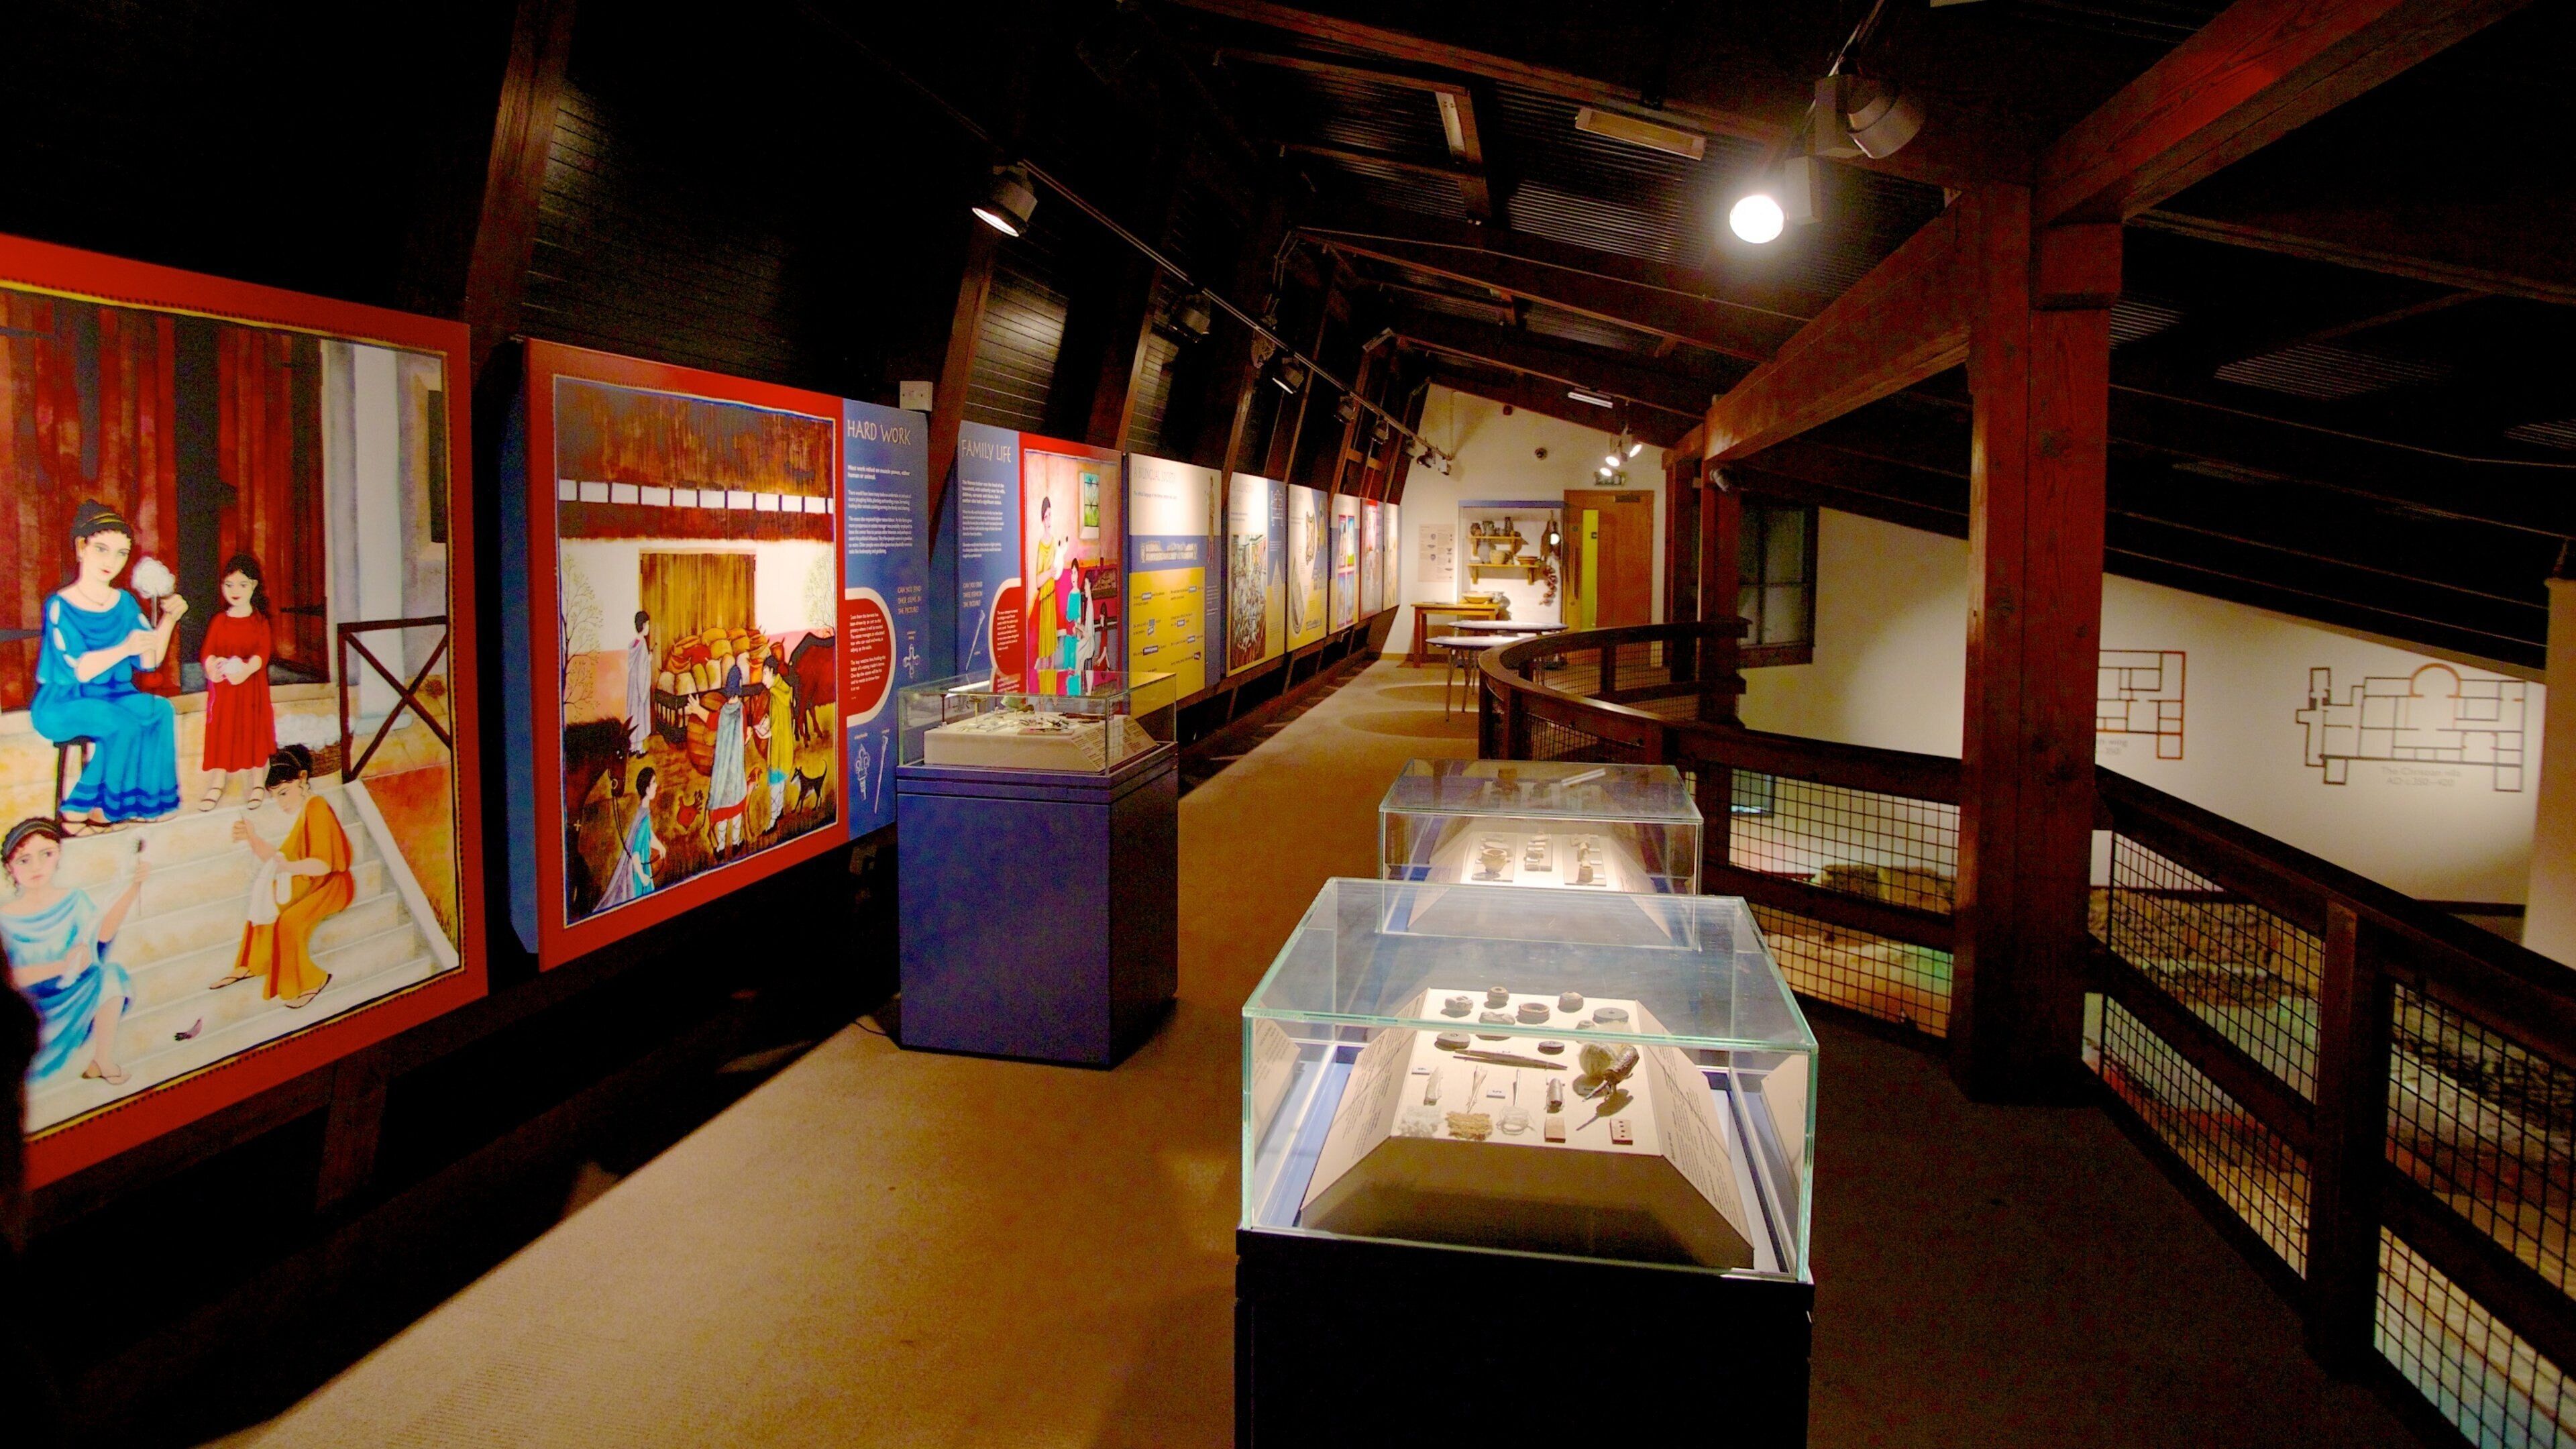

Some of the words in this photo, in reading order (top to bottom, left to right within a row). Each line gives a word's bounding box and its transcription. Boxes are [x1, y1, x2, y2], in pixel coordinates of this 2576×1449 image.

[847, 419, 877, 441] HARD
[880, 424, 911, 446] WORK
[961, 439, 994, 462] FAMILY
[996, 444, 1012, 463] LIFE
